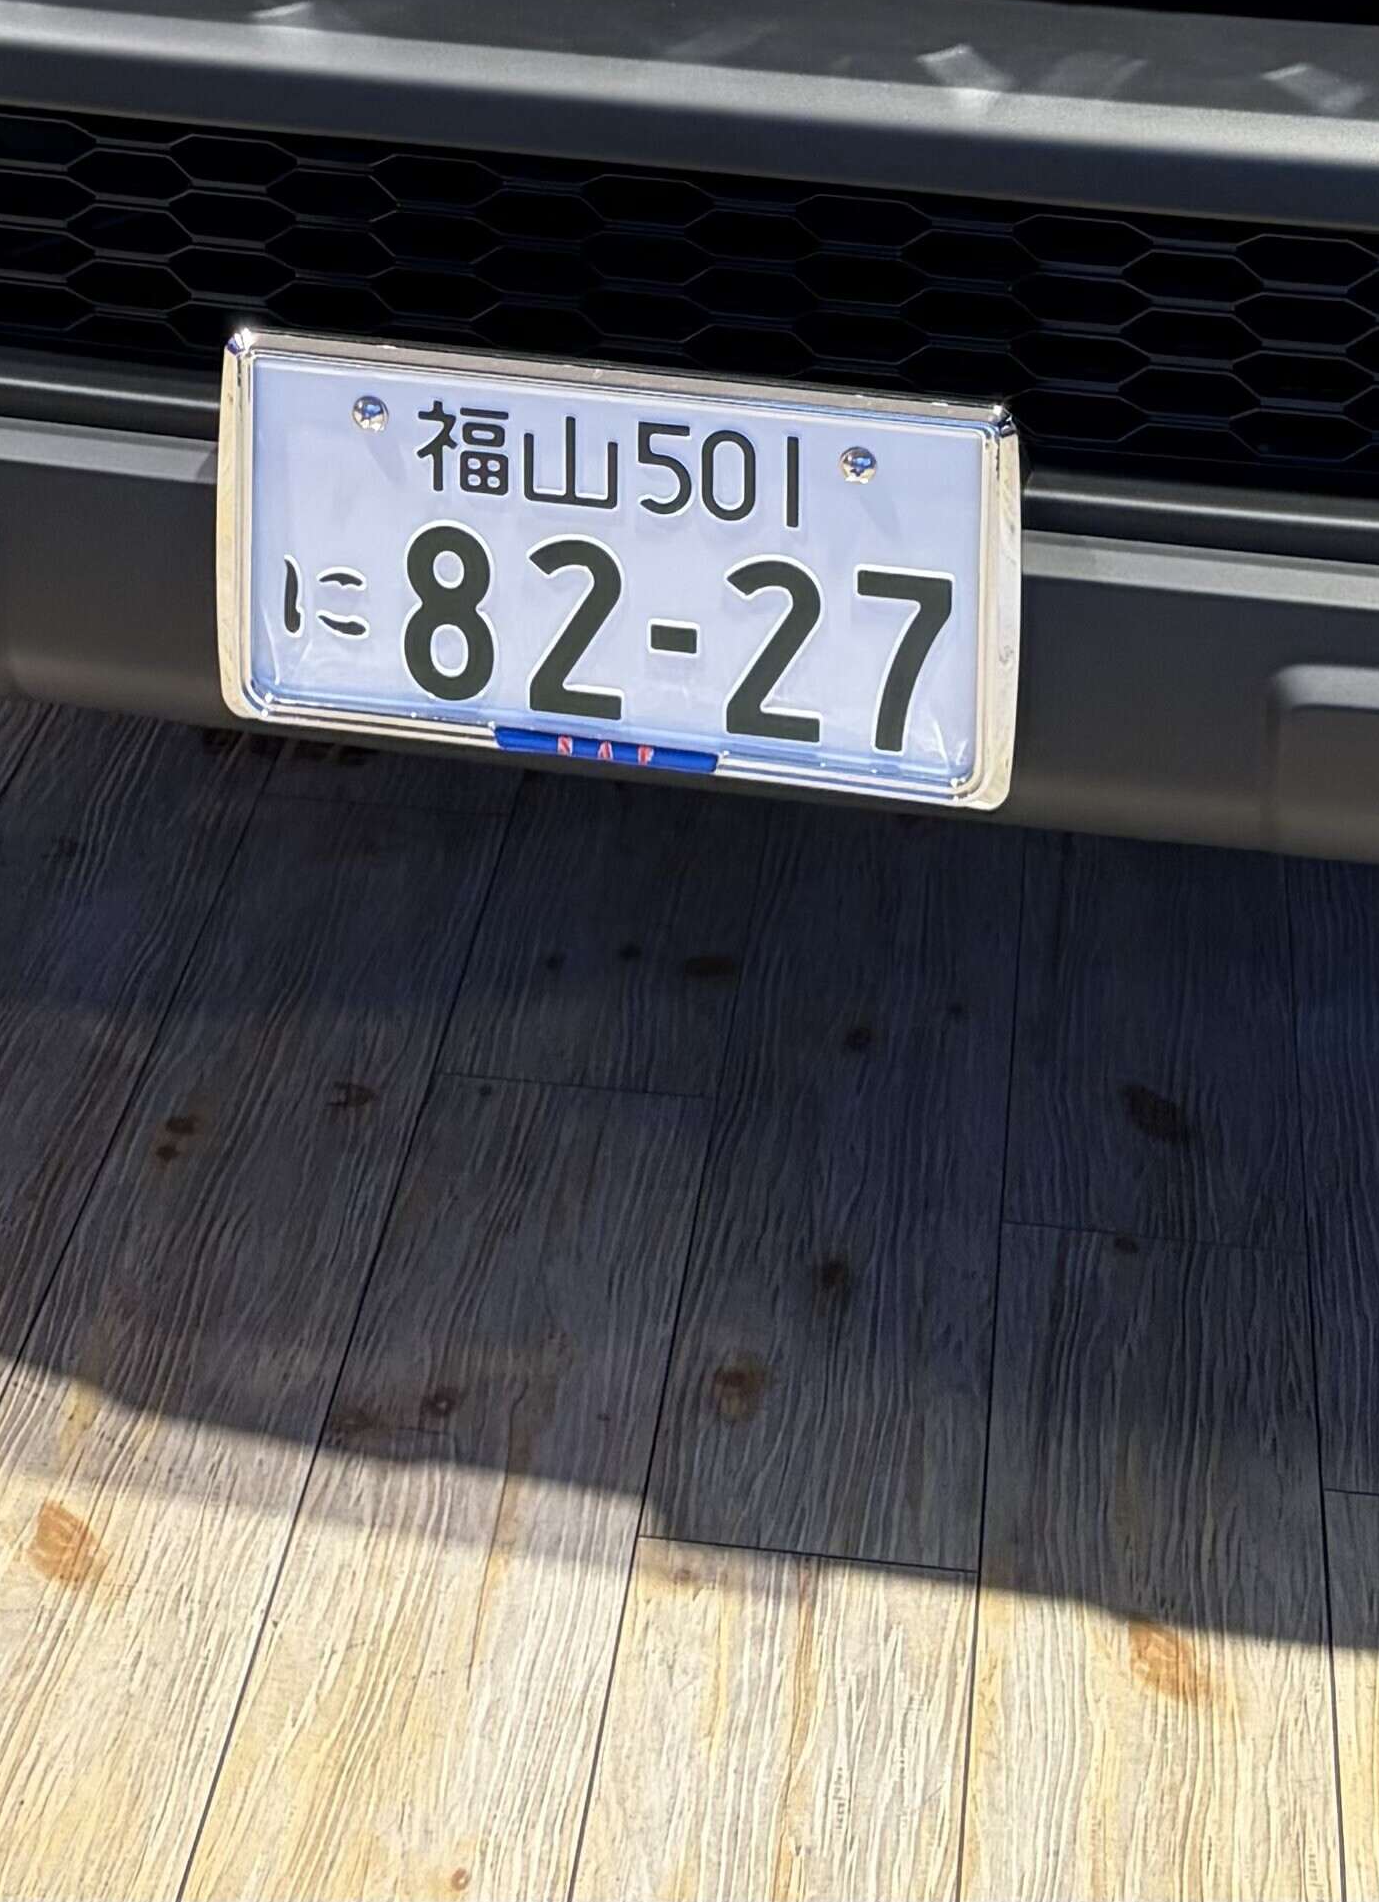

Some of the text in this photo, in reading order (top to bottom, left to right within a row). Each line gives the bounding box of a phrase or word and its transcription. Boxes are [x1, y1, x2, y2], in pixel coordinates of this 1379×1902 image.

[415, 399, 800, 530] 福山501
[282, 522, 955, 754] に 82-27
